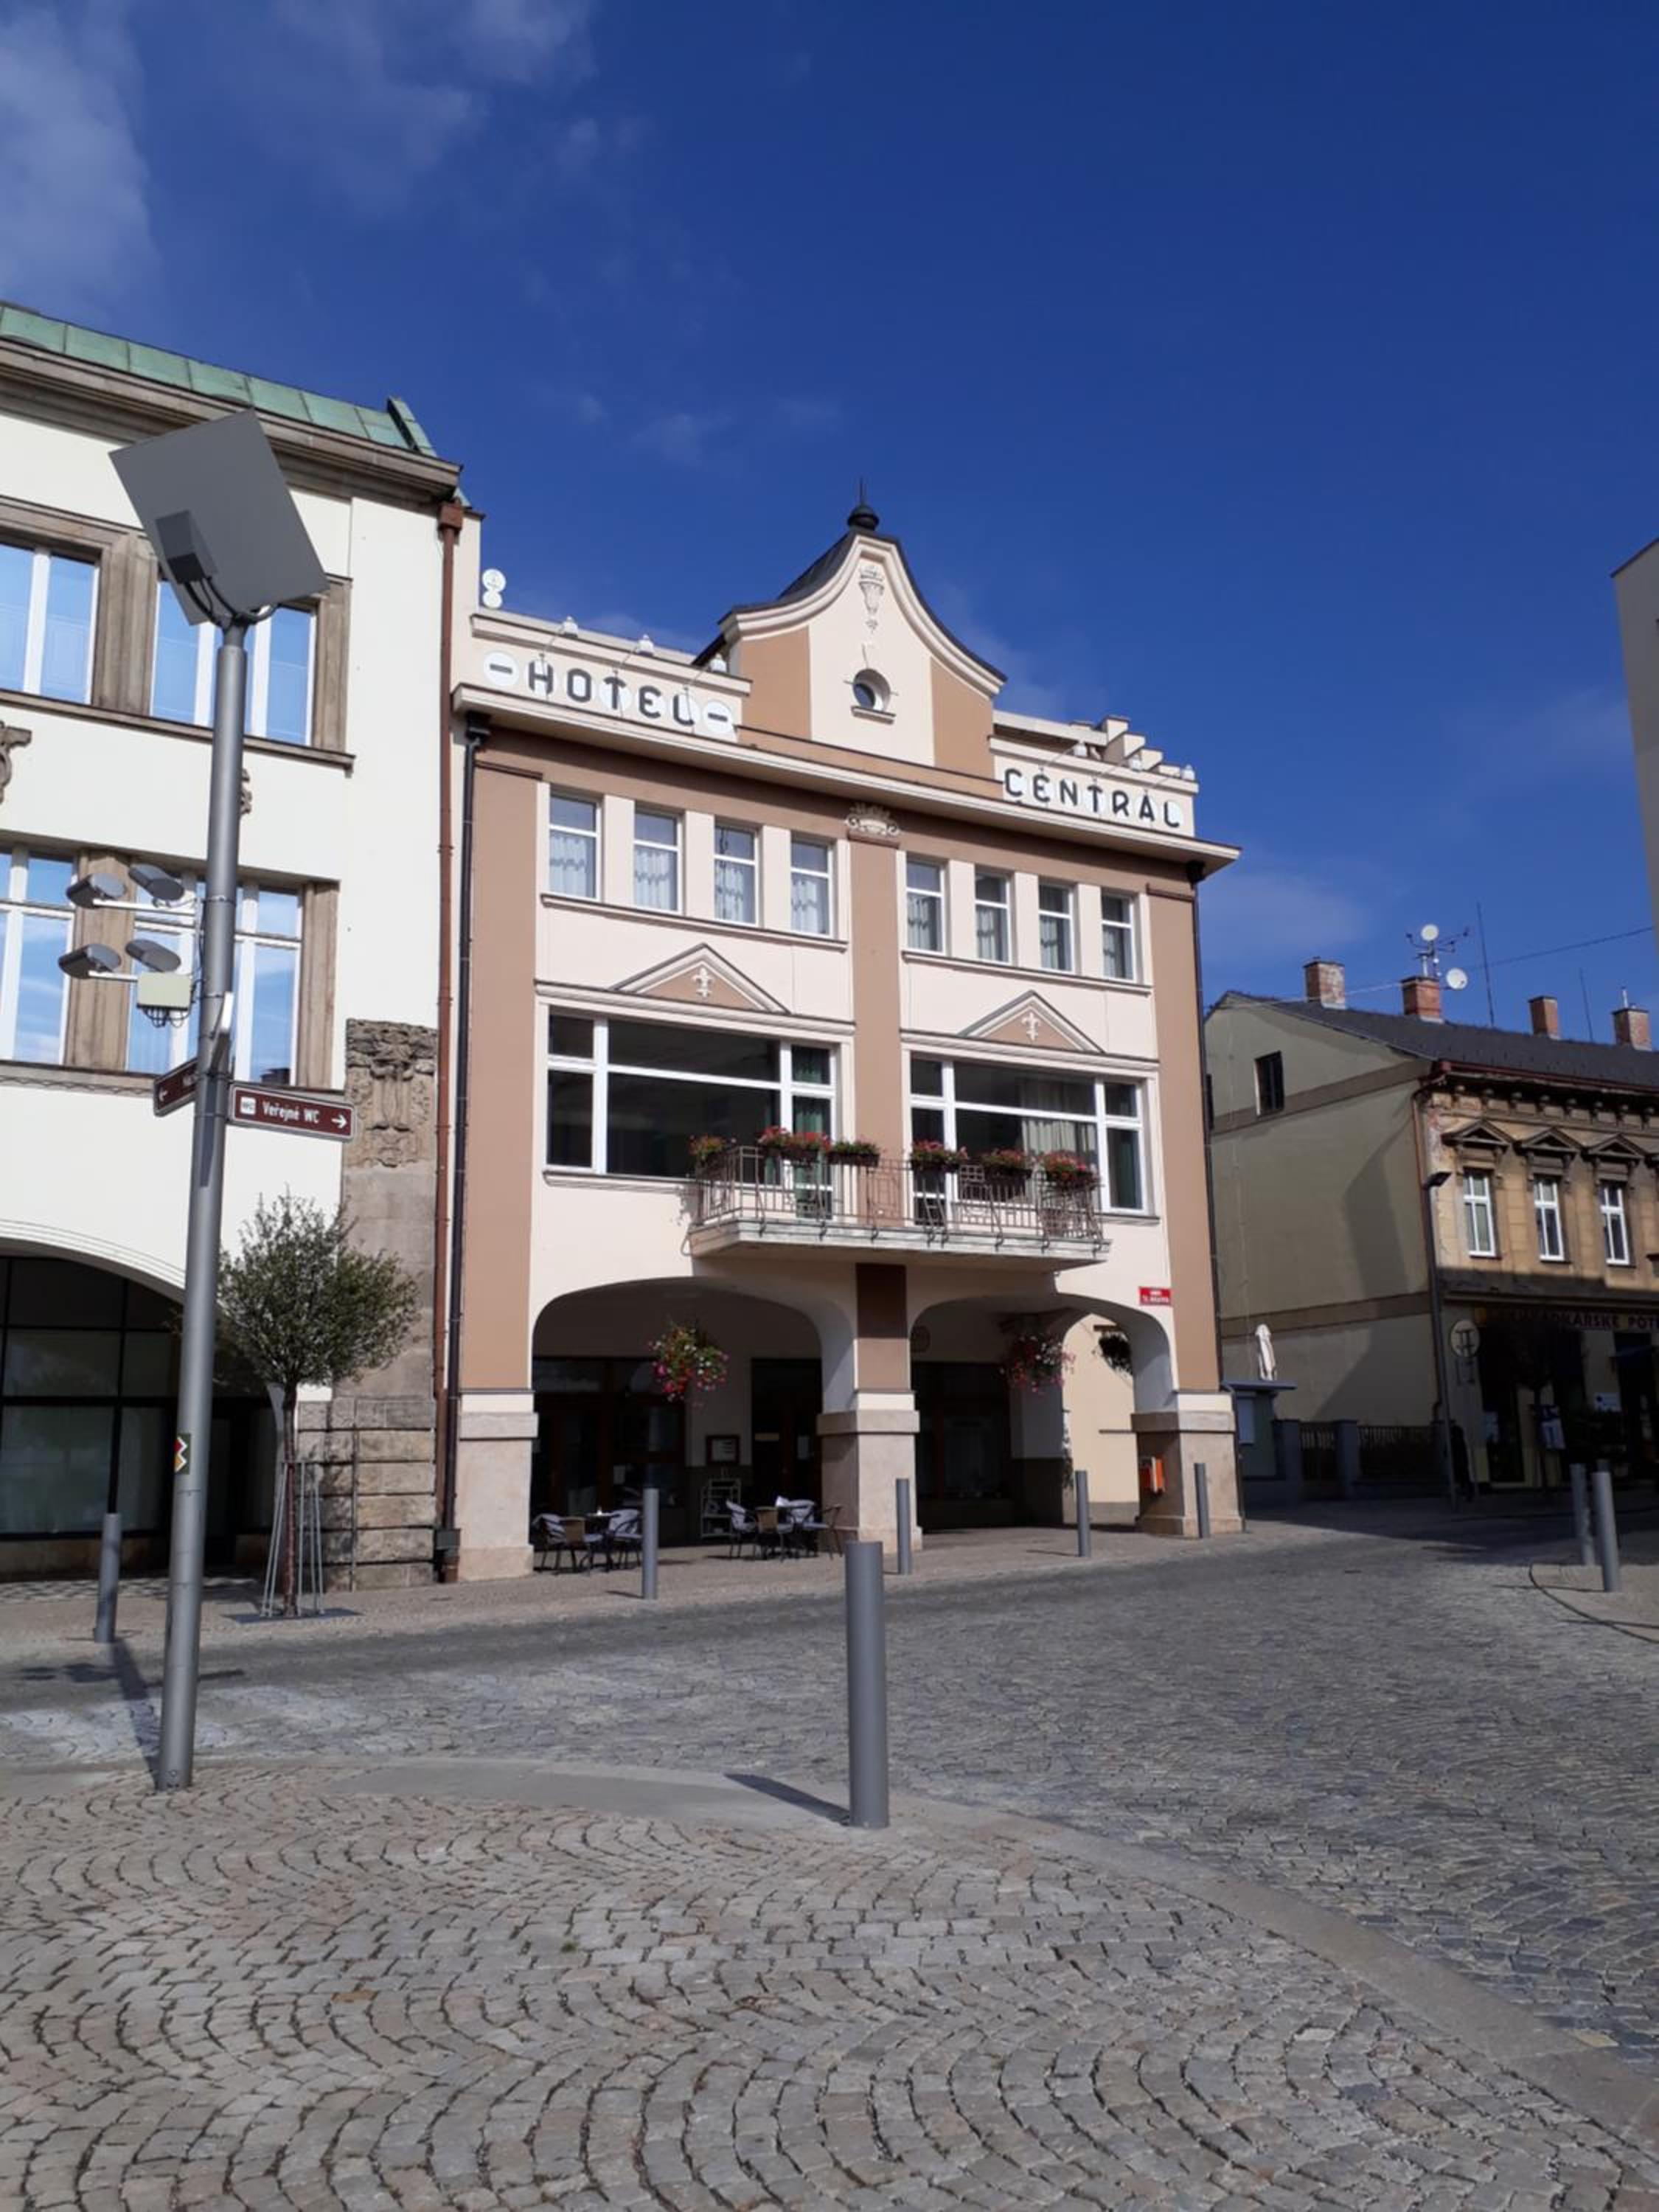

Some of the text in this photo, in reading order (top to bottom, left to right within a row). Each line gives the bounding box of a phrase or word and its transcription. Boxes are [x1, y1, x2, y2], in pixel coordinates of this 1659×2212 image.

[528, 659, 695, 726] HOTEL
[1004, 768, 1180, 828] CENTRAL
[304, 1108, 319, 1124] WC
[1628, 1315, 1659, 1331] POT
